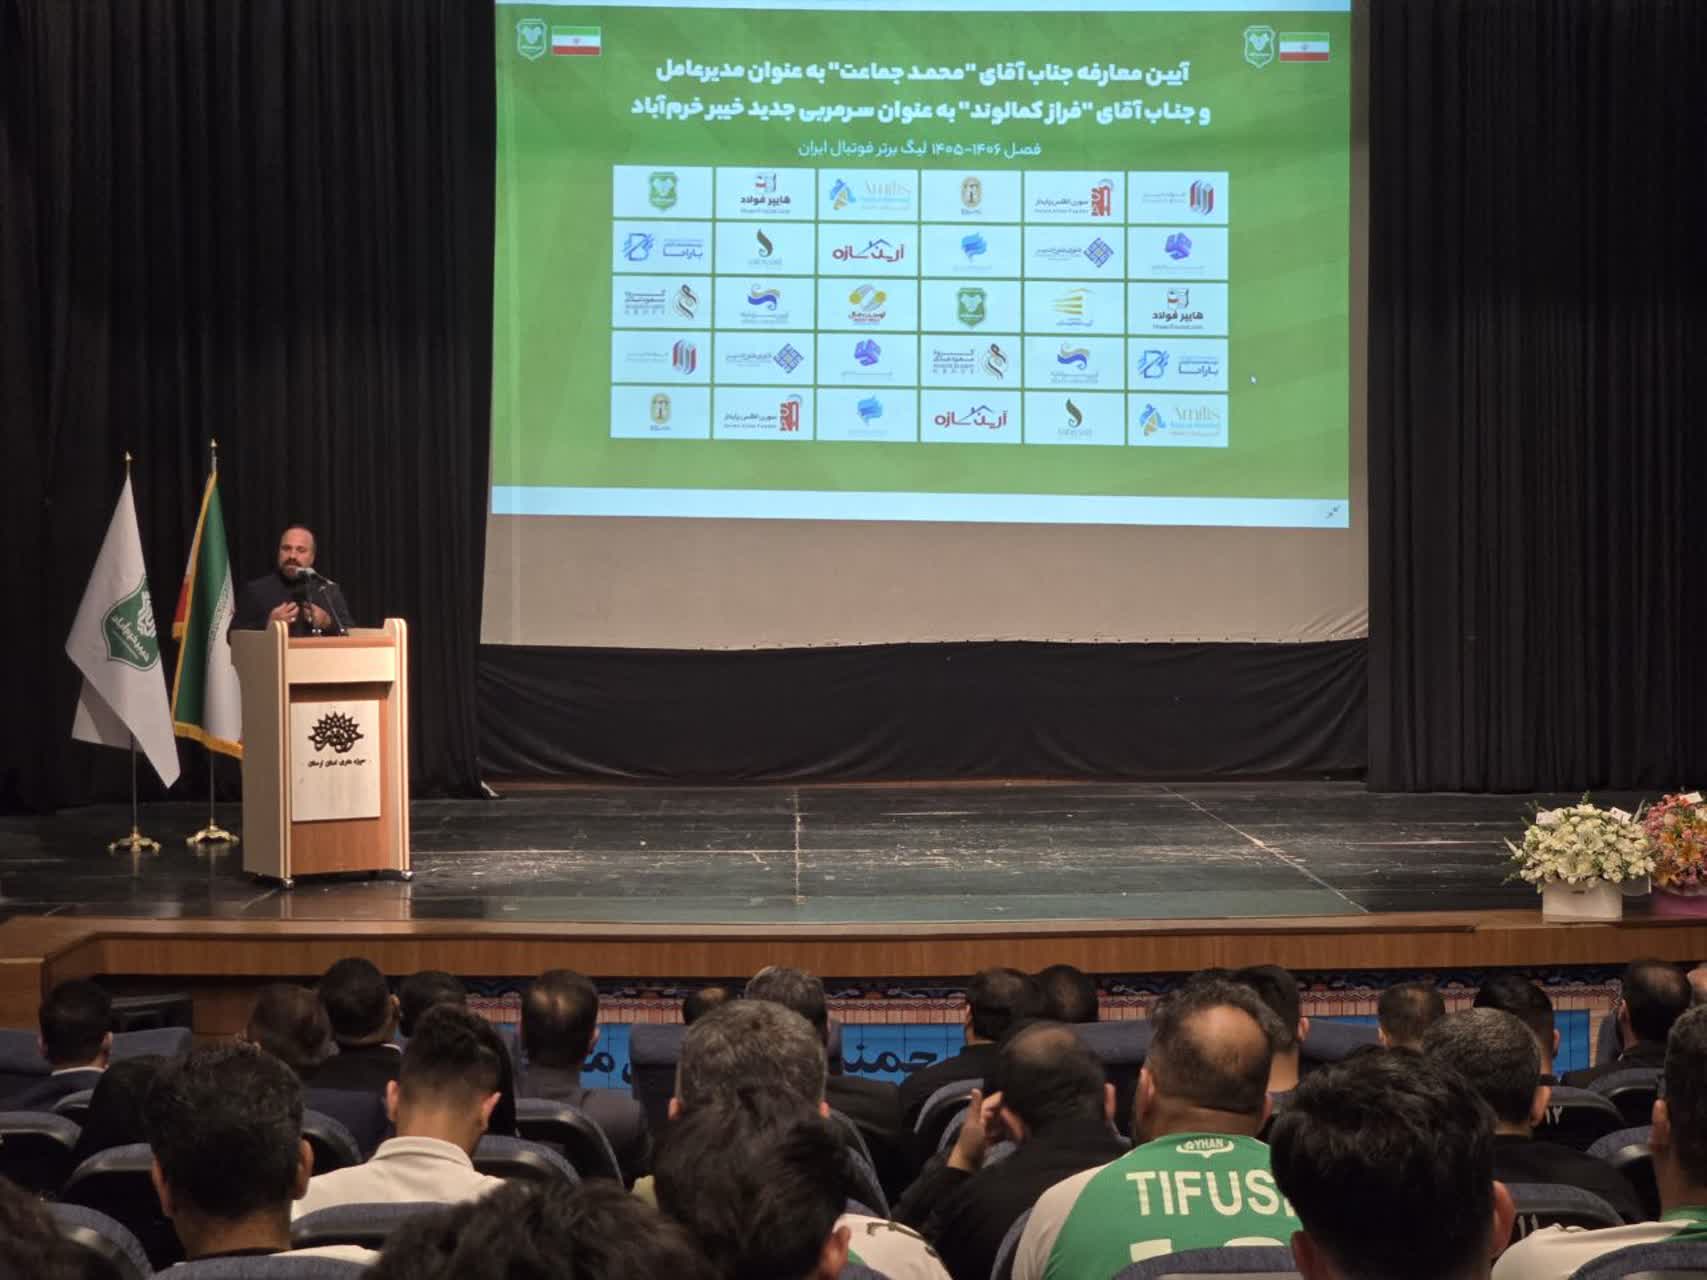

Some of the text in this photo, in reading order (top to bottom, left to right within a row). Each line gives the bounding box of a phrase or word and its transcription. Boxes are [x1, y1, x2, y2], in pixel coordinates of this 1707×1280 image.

[748, 60, 802, 84] عنوان
[806, 64, 826, 84] به
[979, 61, 1026, 86] آقای
[1027, 63, 1074, 86] جناب
[1078, 63, 1143, 87] معارفه
[1146, 61, 1191, 86] آیین
[704, 97, 744, 121] خیبر
[747, 101, 796, 122] جدید
[798, 103, 875, 124] سرمربی
[877, 100, 934, 125] عنوان
[936, 103, 956, 124] به
[1096, 99, 1143, 125] آقای
[1144, 101, 1195, 126] جناب
[1199, 106, 1211, 126] و
[798, 139, 828, 158] ایران
[829, 140, 873, 158] فوتبال
[874, 142, 898, 158] برتر
[899, 139, 928, 157] لیگ
[1003, 141, 1042, 159] فصل
